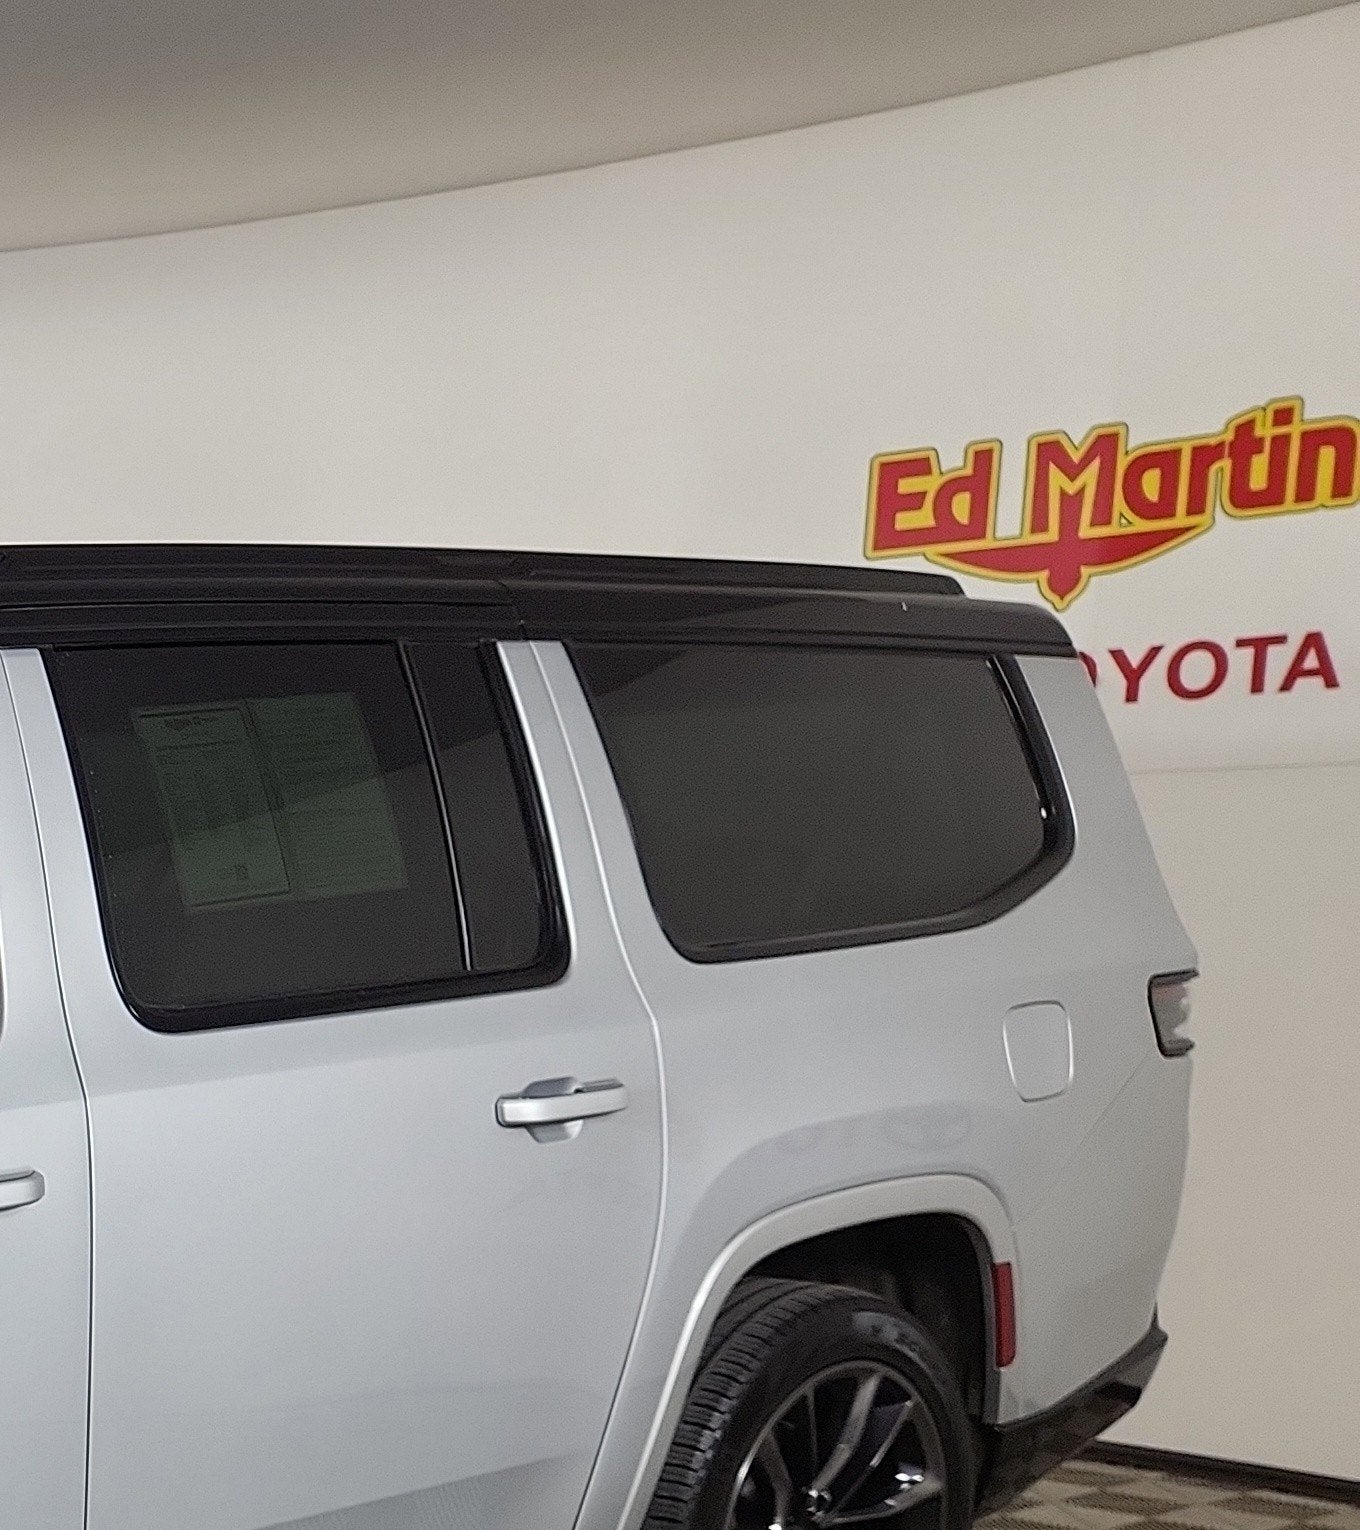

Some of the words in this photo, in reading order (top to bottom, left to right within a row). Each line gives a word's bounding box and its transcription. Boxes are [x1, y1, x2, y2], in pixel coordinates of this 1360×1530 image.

[864, 439, 1002, 559] Ed
[1023, 395, 1360, 540] Martin
[1078, 631, 1340, 704] YOTA
